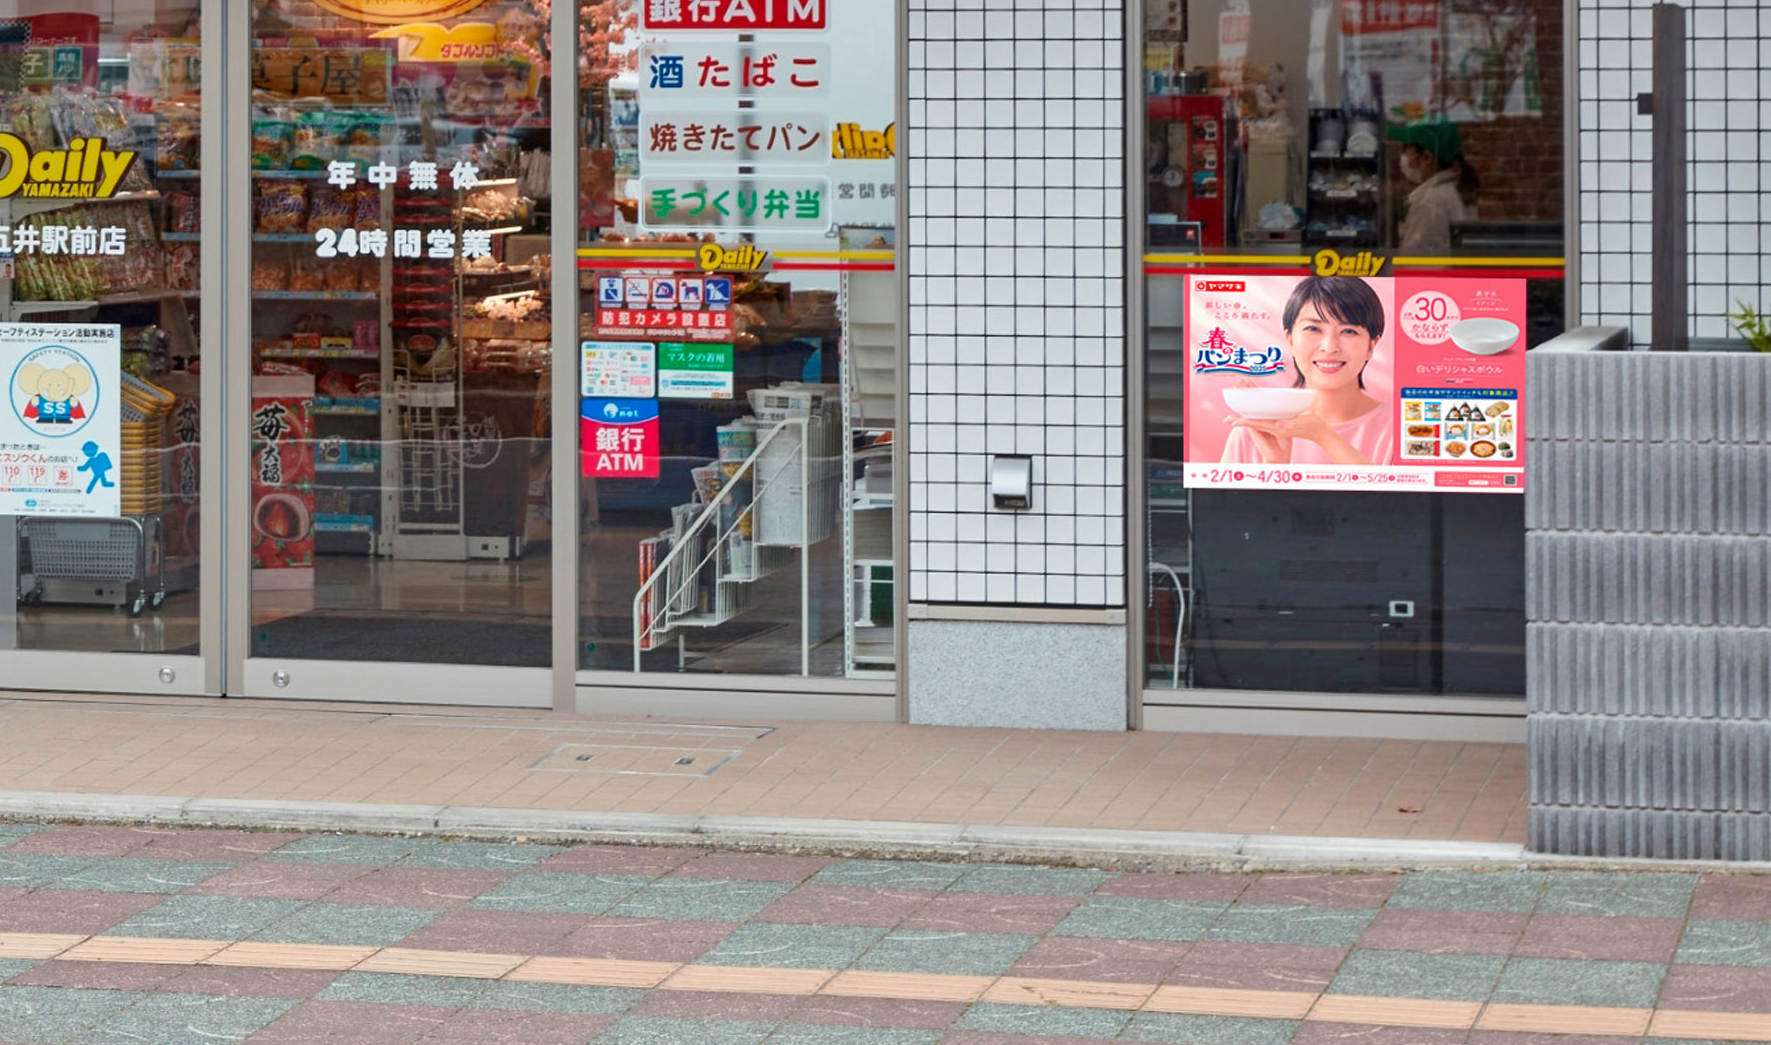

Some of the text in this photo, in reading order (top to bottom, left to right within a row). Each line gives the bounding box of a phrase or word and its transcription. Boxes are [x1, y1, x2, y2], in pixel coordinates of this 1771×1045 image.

[649, 53, 820, 89] 酒 たばこ
[649, 122, 820, 152] 焼きたてパン
[327, 160, 479, 191] 年中無休
[21, 183, 95, 198] YAMAZAKI
[651, 187, 820, 219] 手づくり弁当
[315, 227, 492, 259] 24時間営業
[699, 243, 768, 270] Daily
[1315, 249, 1387, 276] Daily
[1414, 297, 1447, 321] 30
[1197, 346, 1282, 366] パンまつり
[43, 402, 66, 414] SS
[252, 401, 288, 486] 苺大福
[596, 427, 645, 452] 銀行
[4, 466, 19, 475] 110
[30, 466, 45, 476] 119
[596, 453, 644, 471] ATM
